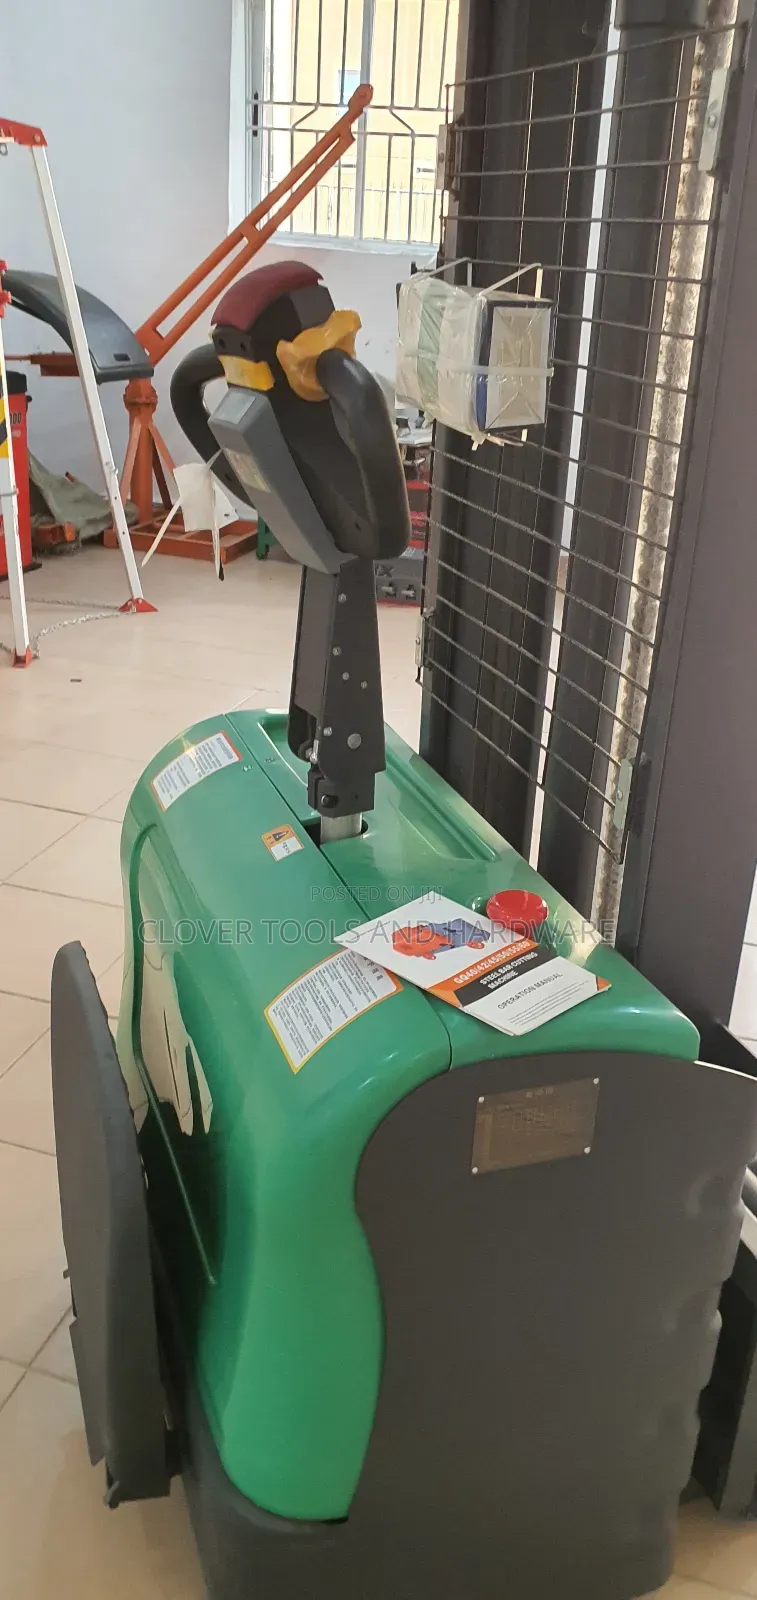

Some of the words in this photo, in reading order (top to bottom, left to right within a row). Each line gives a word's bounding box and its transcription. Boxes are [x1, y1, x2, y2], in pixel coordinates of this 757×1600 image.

[480, 970, 501, 985] STEEL
[498, 964, 513, 977] BAR
[511, 951, 538, 968] CUTTING
[488, 970, 519, 989] MACHINE
[497, 984, 536, 1010] OPERATION
[534, 972, 563, 989] MANUAL
